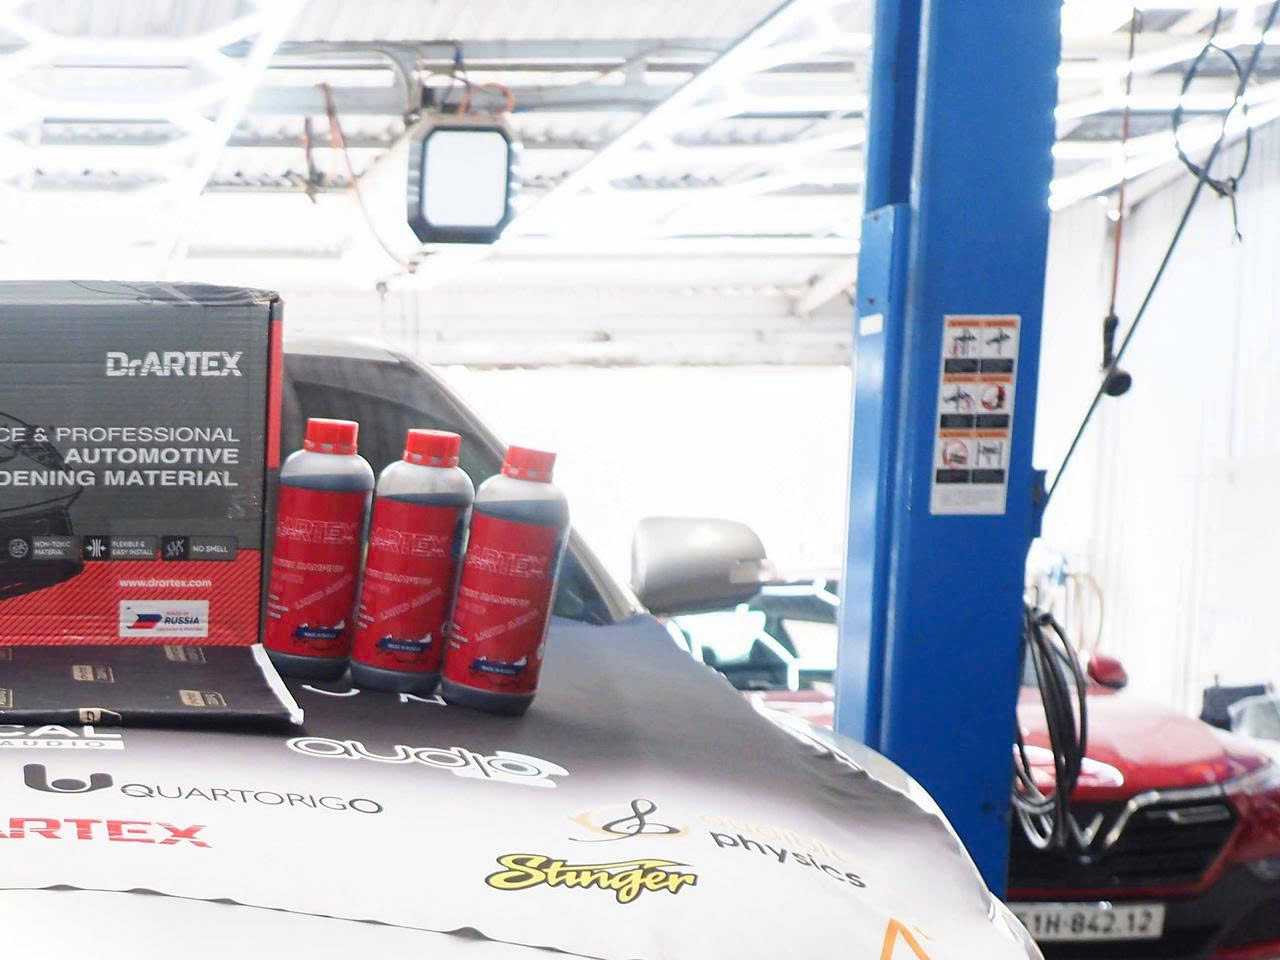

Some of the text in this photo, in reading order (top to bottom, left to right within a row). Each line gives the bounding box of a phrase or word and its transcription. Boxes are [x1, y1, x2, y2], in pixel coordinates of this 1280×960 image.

[106, 351, 243, 376] DrARTEX
[33, 427, 48, 442] &
[56, 427, 241, 442] PROFESSIONAL
[64, 448, 239, 464] AUTOMOTIVE
[104, 471, 238, 486] MATERIAL
[206, 545, 229, 553] SMELL
[119, 578, 212, 588] www.drartex.com
[164, 616, 200, 625] RUSSIA
[120, 783, 384, 814] QUARTORIGO
[709, 831, 867, 889] physics
[484, 853, 699, 905] Stinger
